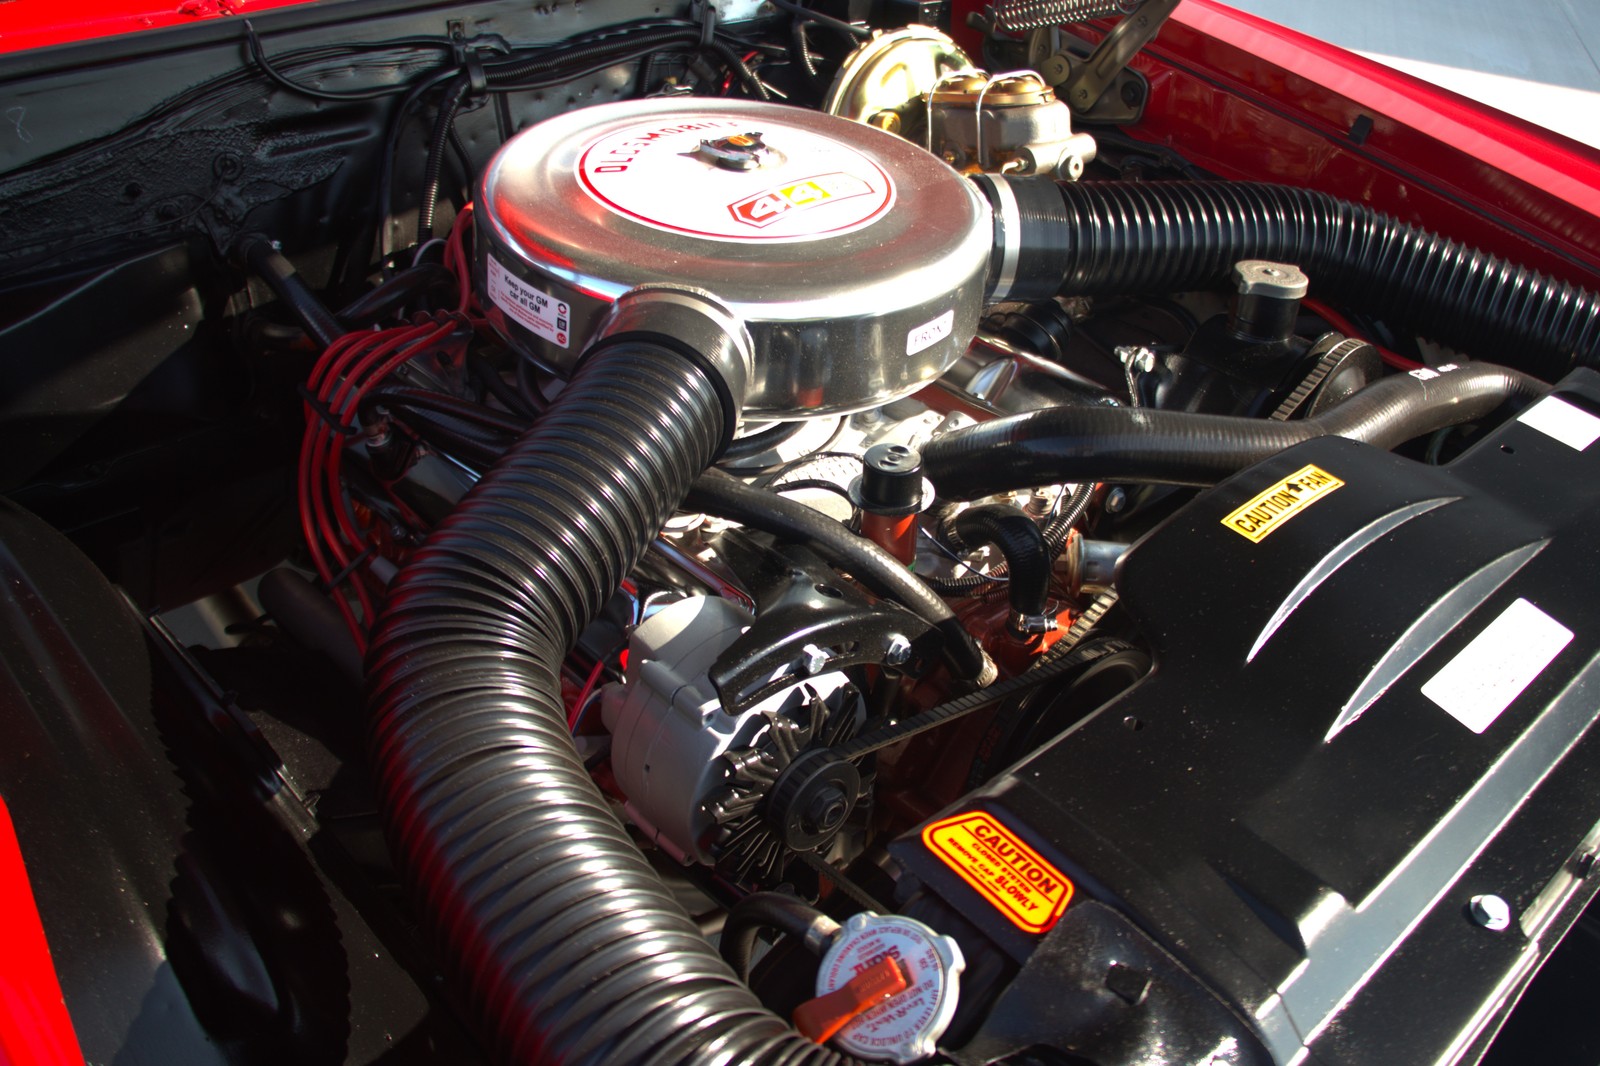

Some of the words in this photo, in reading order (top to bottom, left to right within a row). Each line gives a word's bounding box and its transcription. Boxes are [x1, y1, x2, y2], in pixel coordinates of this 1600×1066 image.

[504, 274, 519, 291] Keep
[519, 287, 535, 300] your
[536, 296, 548, 308] GM
[509, 290, 519, 300] car
[519, 297, 528, 306] all
[528, 302, 541, 314] GM
[1235, 489, 1300, 533] CAUTION
[1299, 471, 1333, 491] FAN
[974, 825, 1058, 894] CAUTION
[995, 875, 1039, 911] SLOWLY
